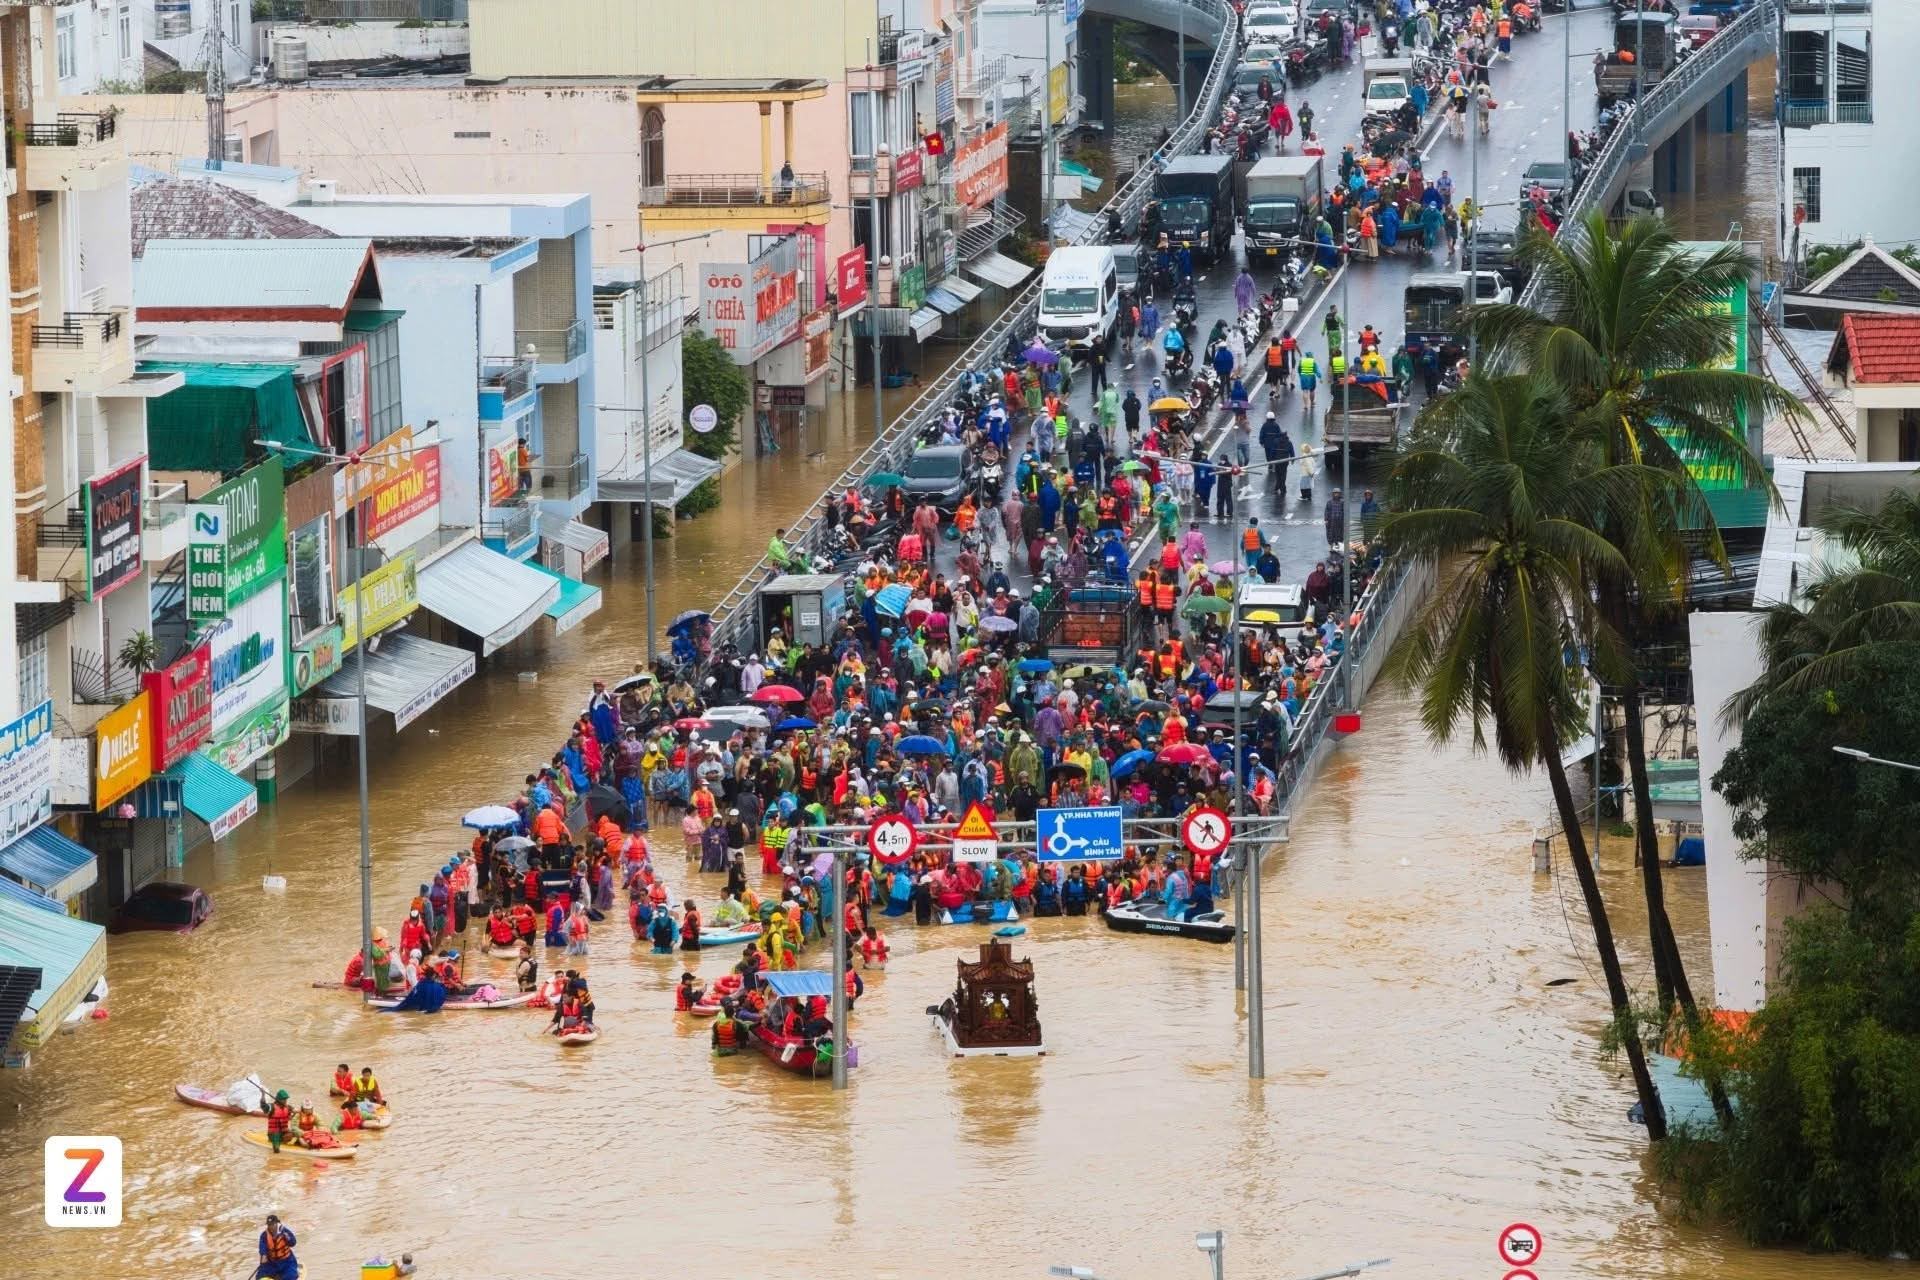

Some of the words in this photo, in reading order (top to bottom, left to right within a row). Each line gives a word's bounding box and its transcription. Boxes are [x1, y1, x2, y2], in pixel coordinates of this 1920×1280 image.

[193, 545, 222, 563] THẾ
[192, 569, 223, 588] GIỚI
[192, 593, 223, 615] NỆM
[1094, 810, 1120, 818] TRANG
[877, 830, 908, 846] 4,5m
[961, 847, 988, 855] SLOW
[1084, 848, 1105, 856] BÌNH
